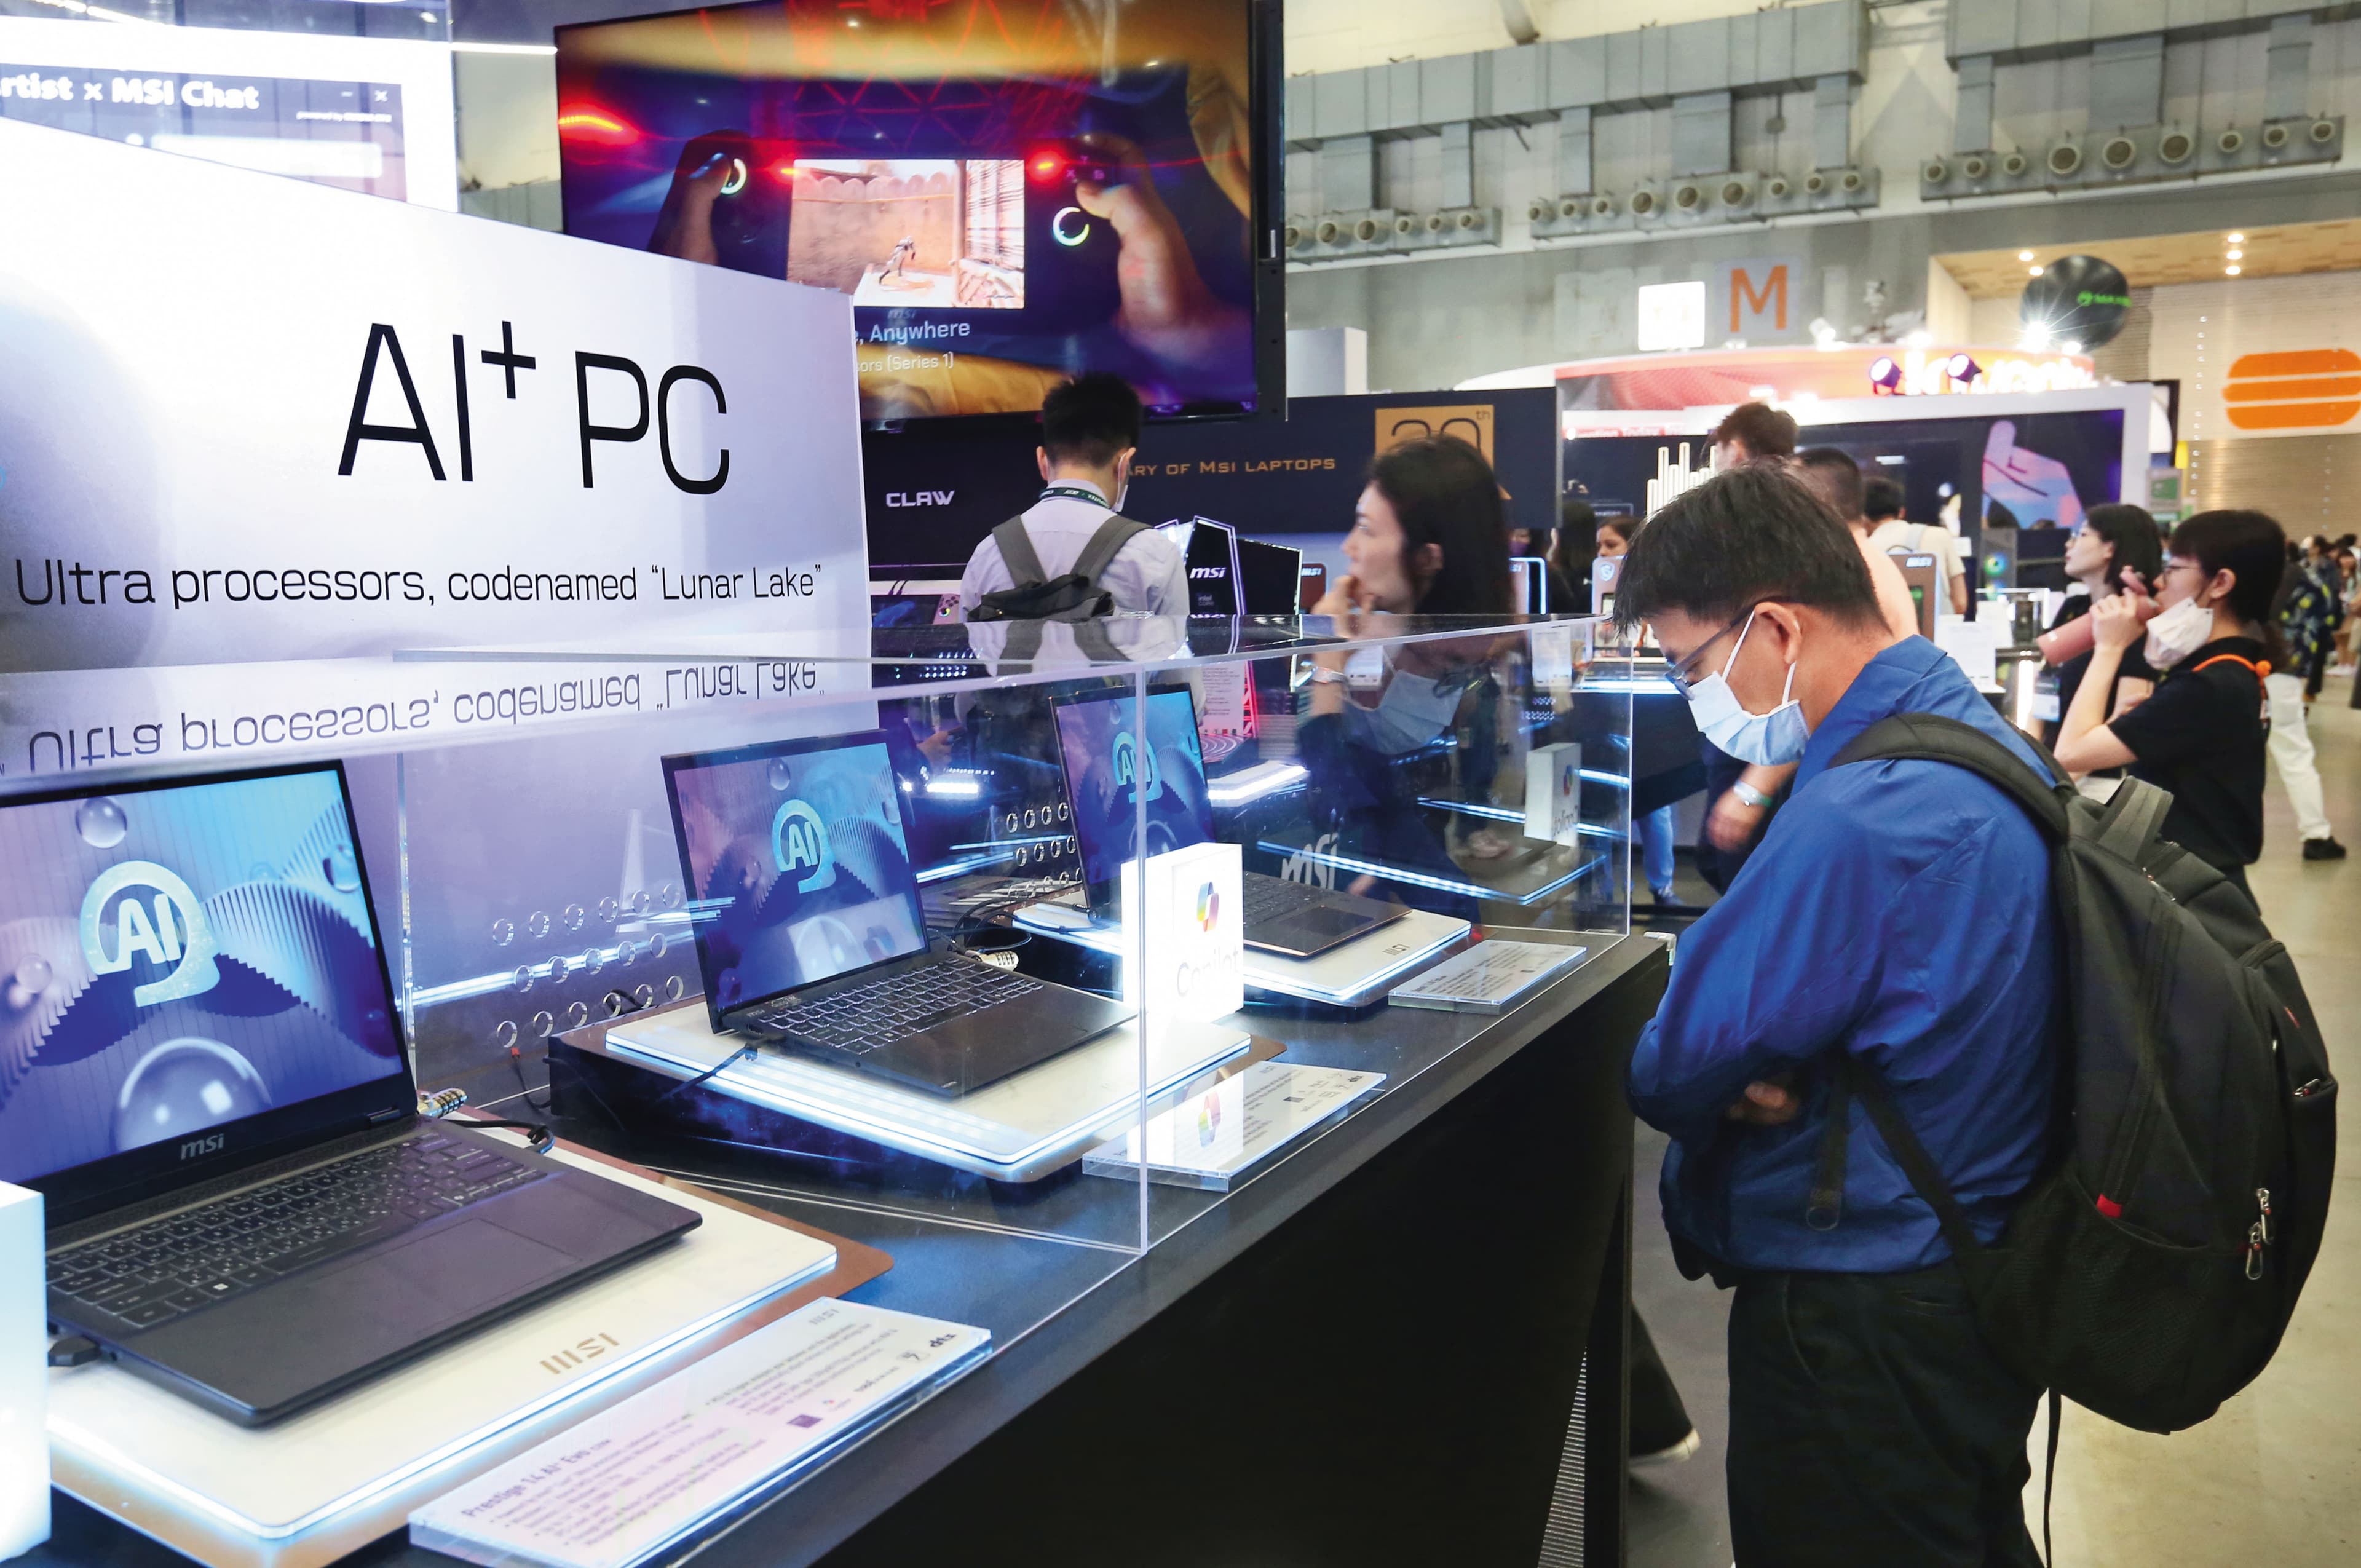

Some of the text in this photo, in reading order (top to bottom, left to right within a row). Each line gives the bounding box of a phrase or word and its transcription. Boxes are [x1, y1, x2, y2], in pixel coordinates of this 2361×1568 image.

[0, 73, 259, 109] rtist x MSI Chat
[1730, 265, 1788, 333] M
[870, 320, 970, 345] Anywhere
[575, 350, 729, 494] PC
[1166, 464, 1191, 475] OF
[1245, 459, 1335, 472] LAPTOPS
[886, 490, 955, 507] CLAW
[16, 559, 156, 606] Ultra
[172, 569, 435, 610] processors,
[448, 564, 637, 601] codenamed
[1190, 567, 1227, 579] msi
[180, 1133, 224, 1160] msi
[461, 1483, 527, 1517] Prestige
